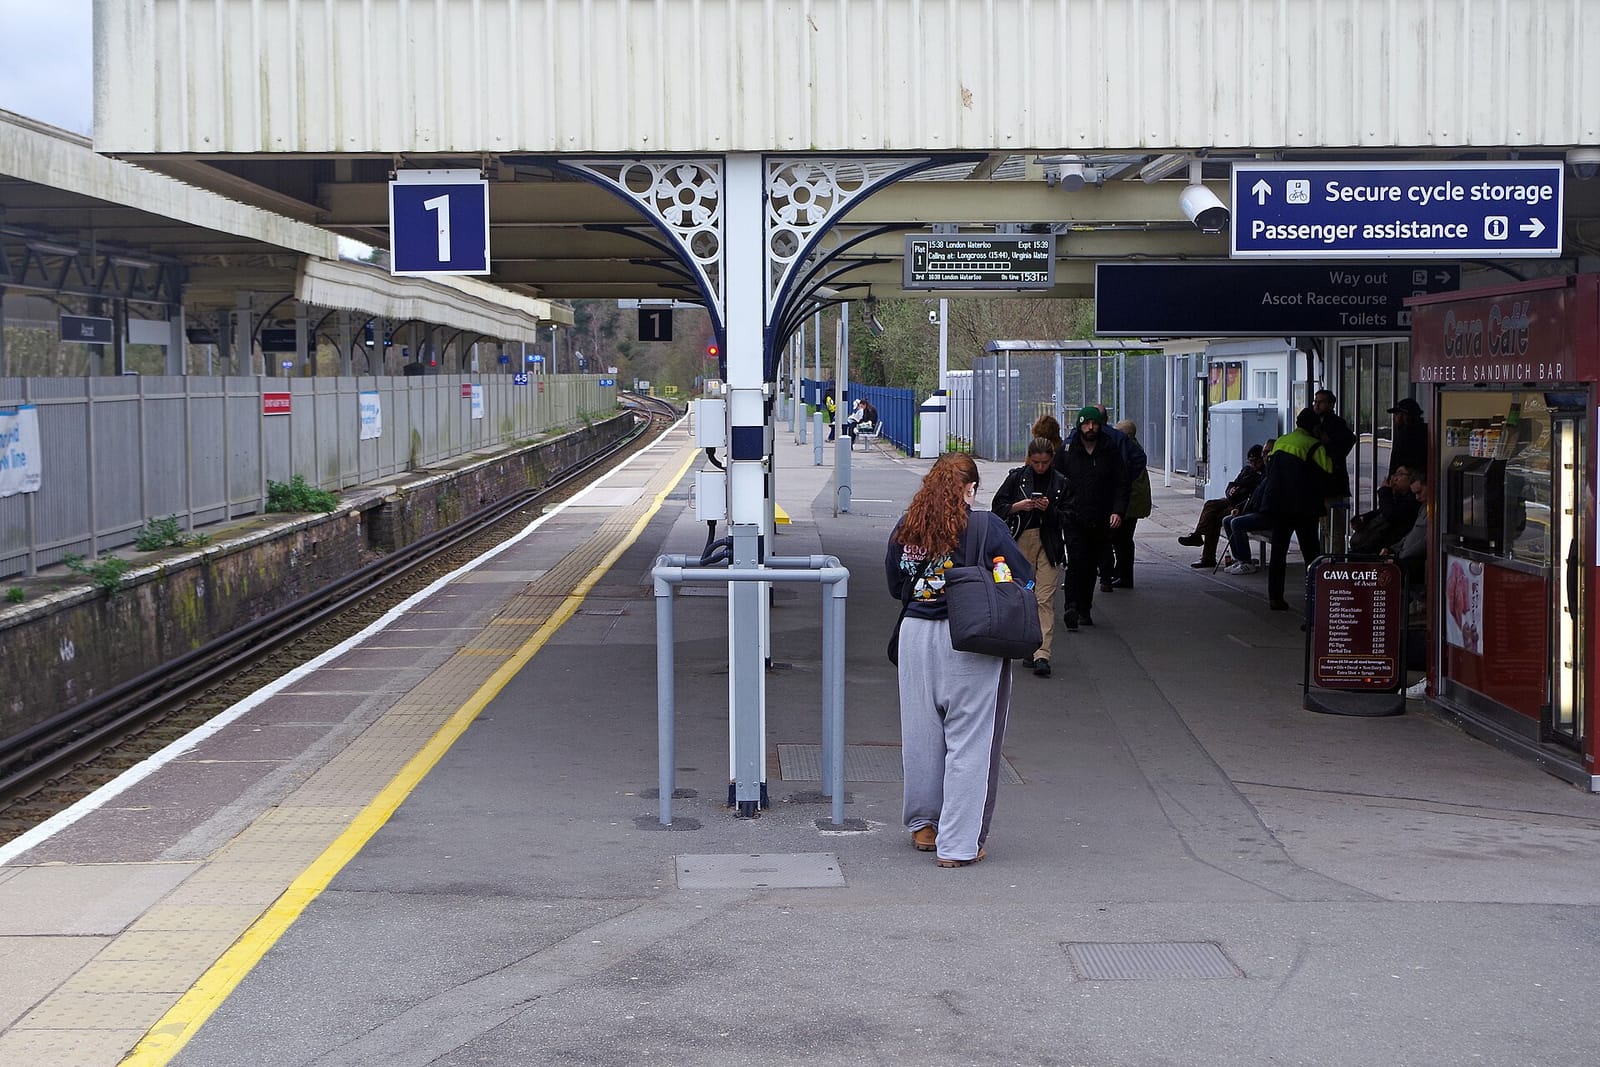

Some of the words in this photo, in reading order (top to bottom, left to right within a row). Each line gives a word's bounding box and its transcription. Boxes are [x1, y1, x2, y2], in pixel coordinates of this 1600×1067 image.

[1325, 181, 1401, 202] Secure
[1408, 180, 1464, 206] cycle
[1470, 182, 1553, 206] storage
[424, 194, 450, 262] 1
[1252, 220, 1357, 244] Passenger
[1362, 220, 1468, 239] assistance
[1018, 241, 1031, 250] Expt
[917, 256, 922, 265] 1
[928, 252, 945, 260] Calling
[958, 252, 986, 260] Longcross
[1012, 252, 1032, 260] Virginia
[1329, 272, 1360, 288] Way
[1364, 273, 1388, 285] out
[1262, 292, 1303, 305] Ascot
[1308, 292, 1387, 305] Racecourse
[650, 313, 660, 338] 1
[1340, 312, 1387, 326] Toilets
[1444, 310, 1482, 360] Cava
[1420, 366, 1456, 381] COFFEE
[1462, 366, 1467, 380] &
[1474, 364, 1531, 380] SANDWICH
[1539, 363, 1562, 380] BAR
[1323, 571, 1349, 580] CAVA
[1352, 569, 1378, 580] CAFÉ
